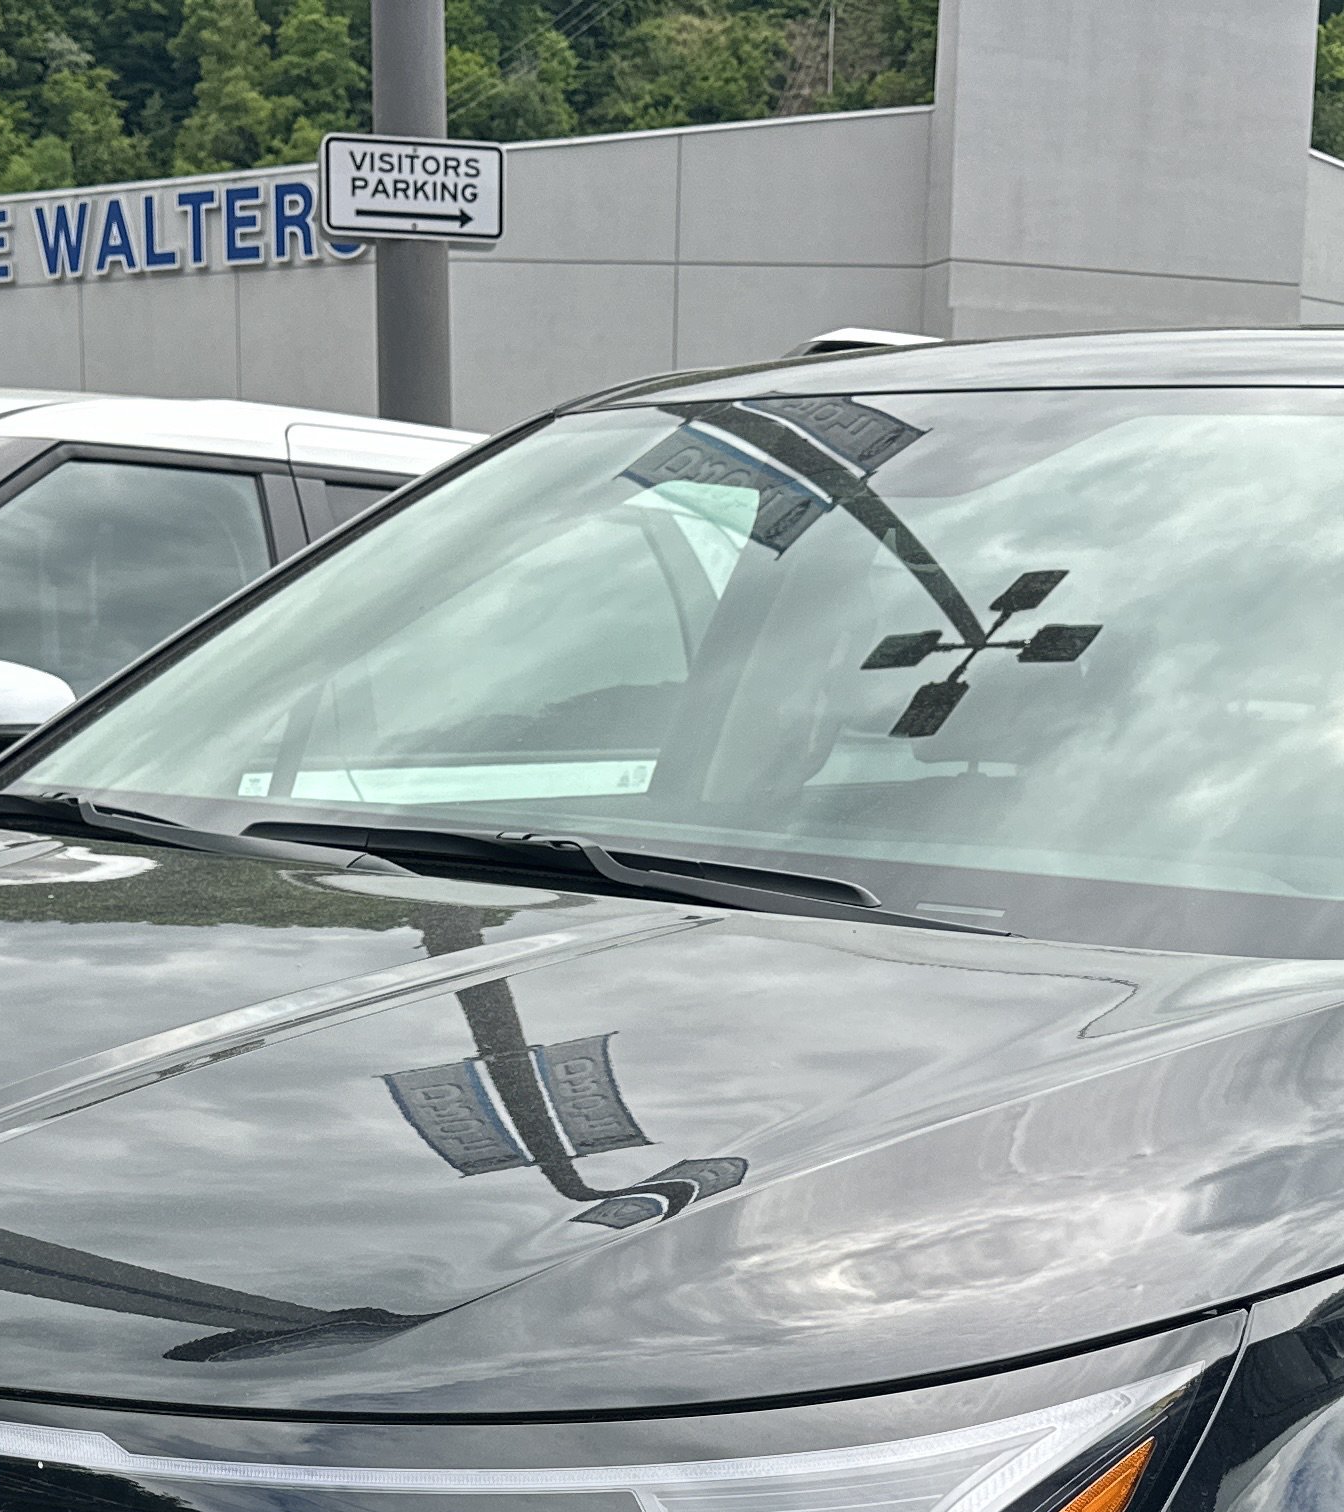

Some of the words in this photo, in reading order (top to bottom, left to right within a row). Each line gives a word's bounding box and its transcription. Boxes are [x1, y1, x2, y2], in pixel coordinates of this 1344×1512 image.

[349, 150, 480, 178] VISITORS
[351, 177, 479, 204] PARKING
[33, 180, 362, 276] WALTER
